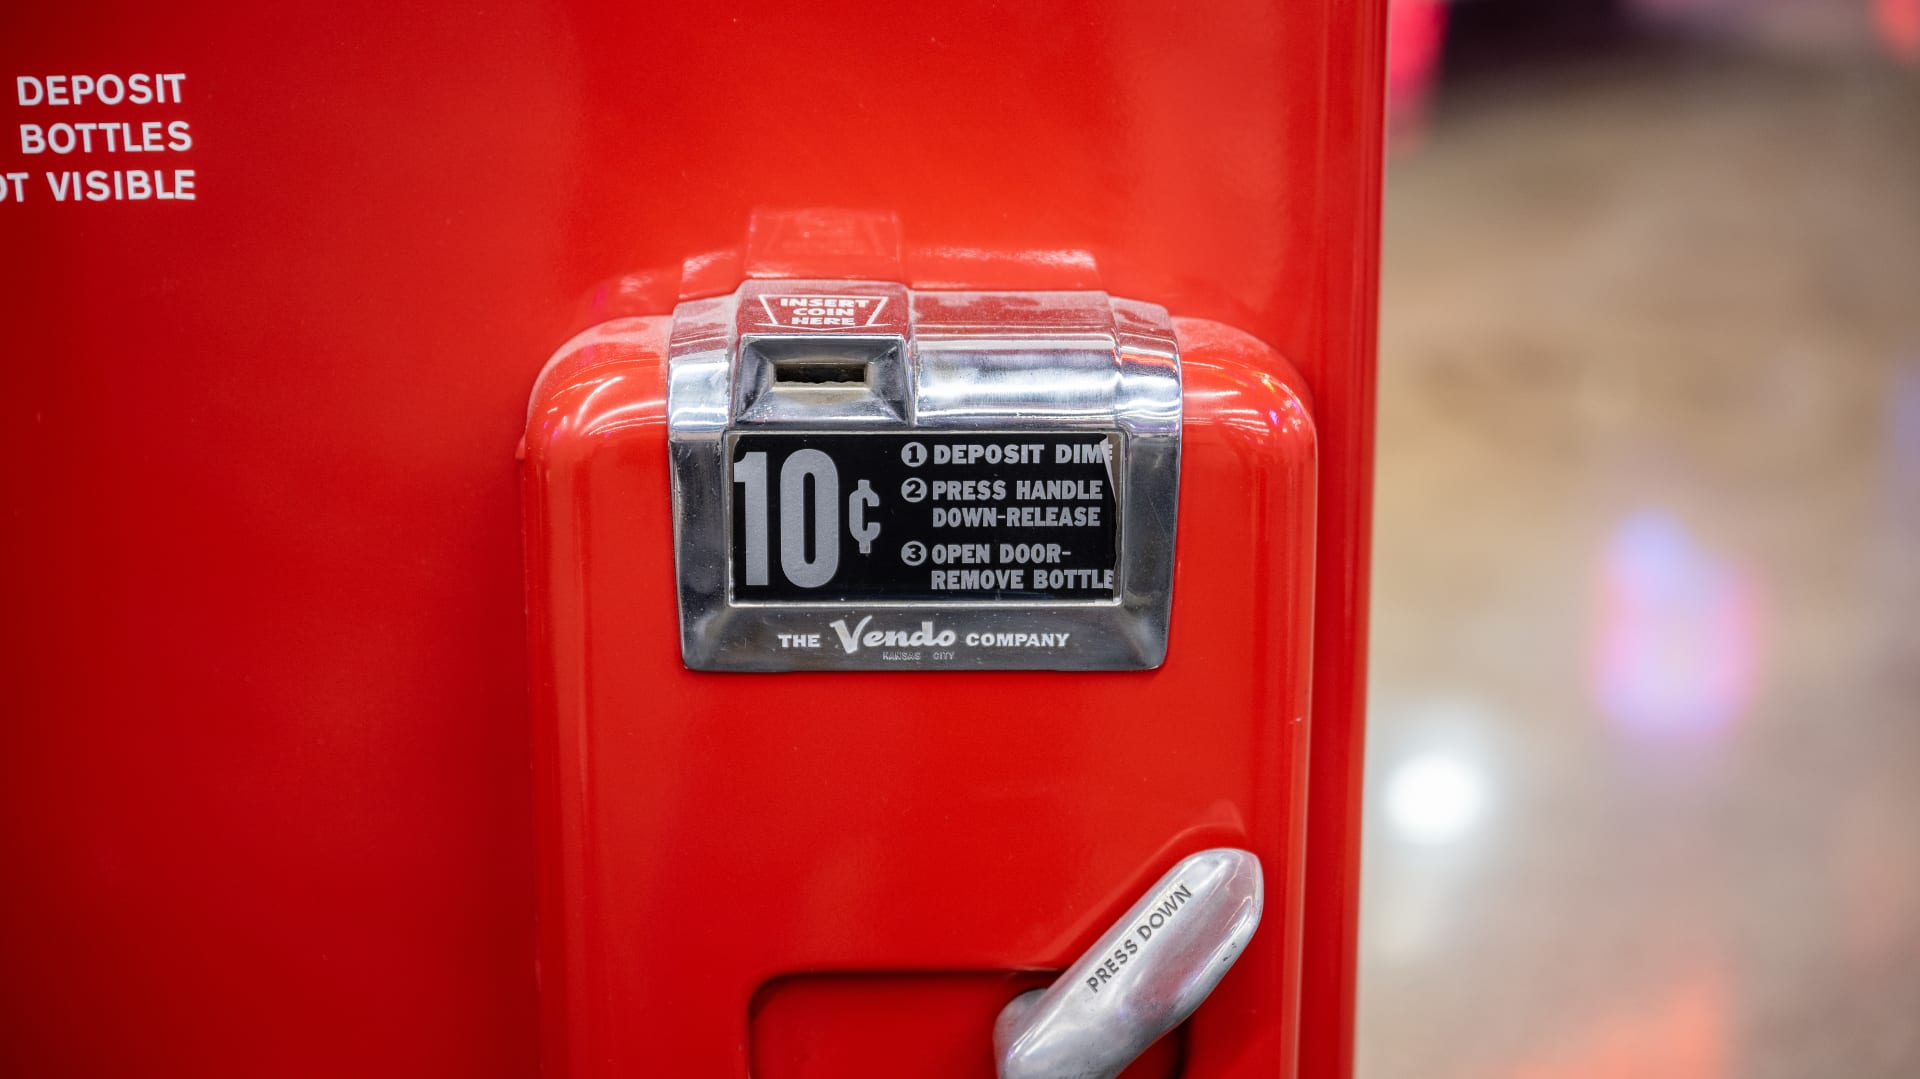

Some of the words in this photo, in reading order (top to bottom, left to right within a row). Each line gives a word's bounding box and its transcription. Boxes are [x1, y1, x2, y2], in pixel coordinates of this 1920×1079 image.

[17, 73, 186, 106] DEPOSIT
[20, 121, 192, 154] BOTTLES
[0, 172, 29, 202] T
[46, 169, 196, 201] VISIBLE
[780, 298, 870, 309] INSERT
[793, 308, 855, 317] COIN
[791, 317, 856, 326] HERE
[934, 444, 1045, 464] DEPOSIT
[932, 480, 1006, 500] PRESS
[1016, 480, 1103, 500] HANDLE
[932, 507, 1101, 527] DOWN-RELEASE
[931, 544, 990, 564] OPEN
[1000, 543, 1071, 564] DOOR-
[931, 569, 1024, 590] REMOVE
[778, 634, 820, 648] THE
[829, 615, 956, 654] Vendo
[965, 633, 1069, 648] COMPANY
[882, 651, 921, 660] KANSAS
[932, 651, 955, 660] CITY
[1086, 939, 1138, 992] PRESS
[1136, 884, 1192, 941] DOWN
